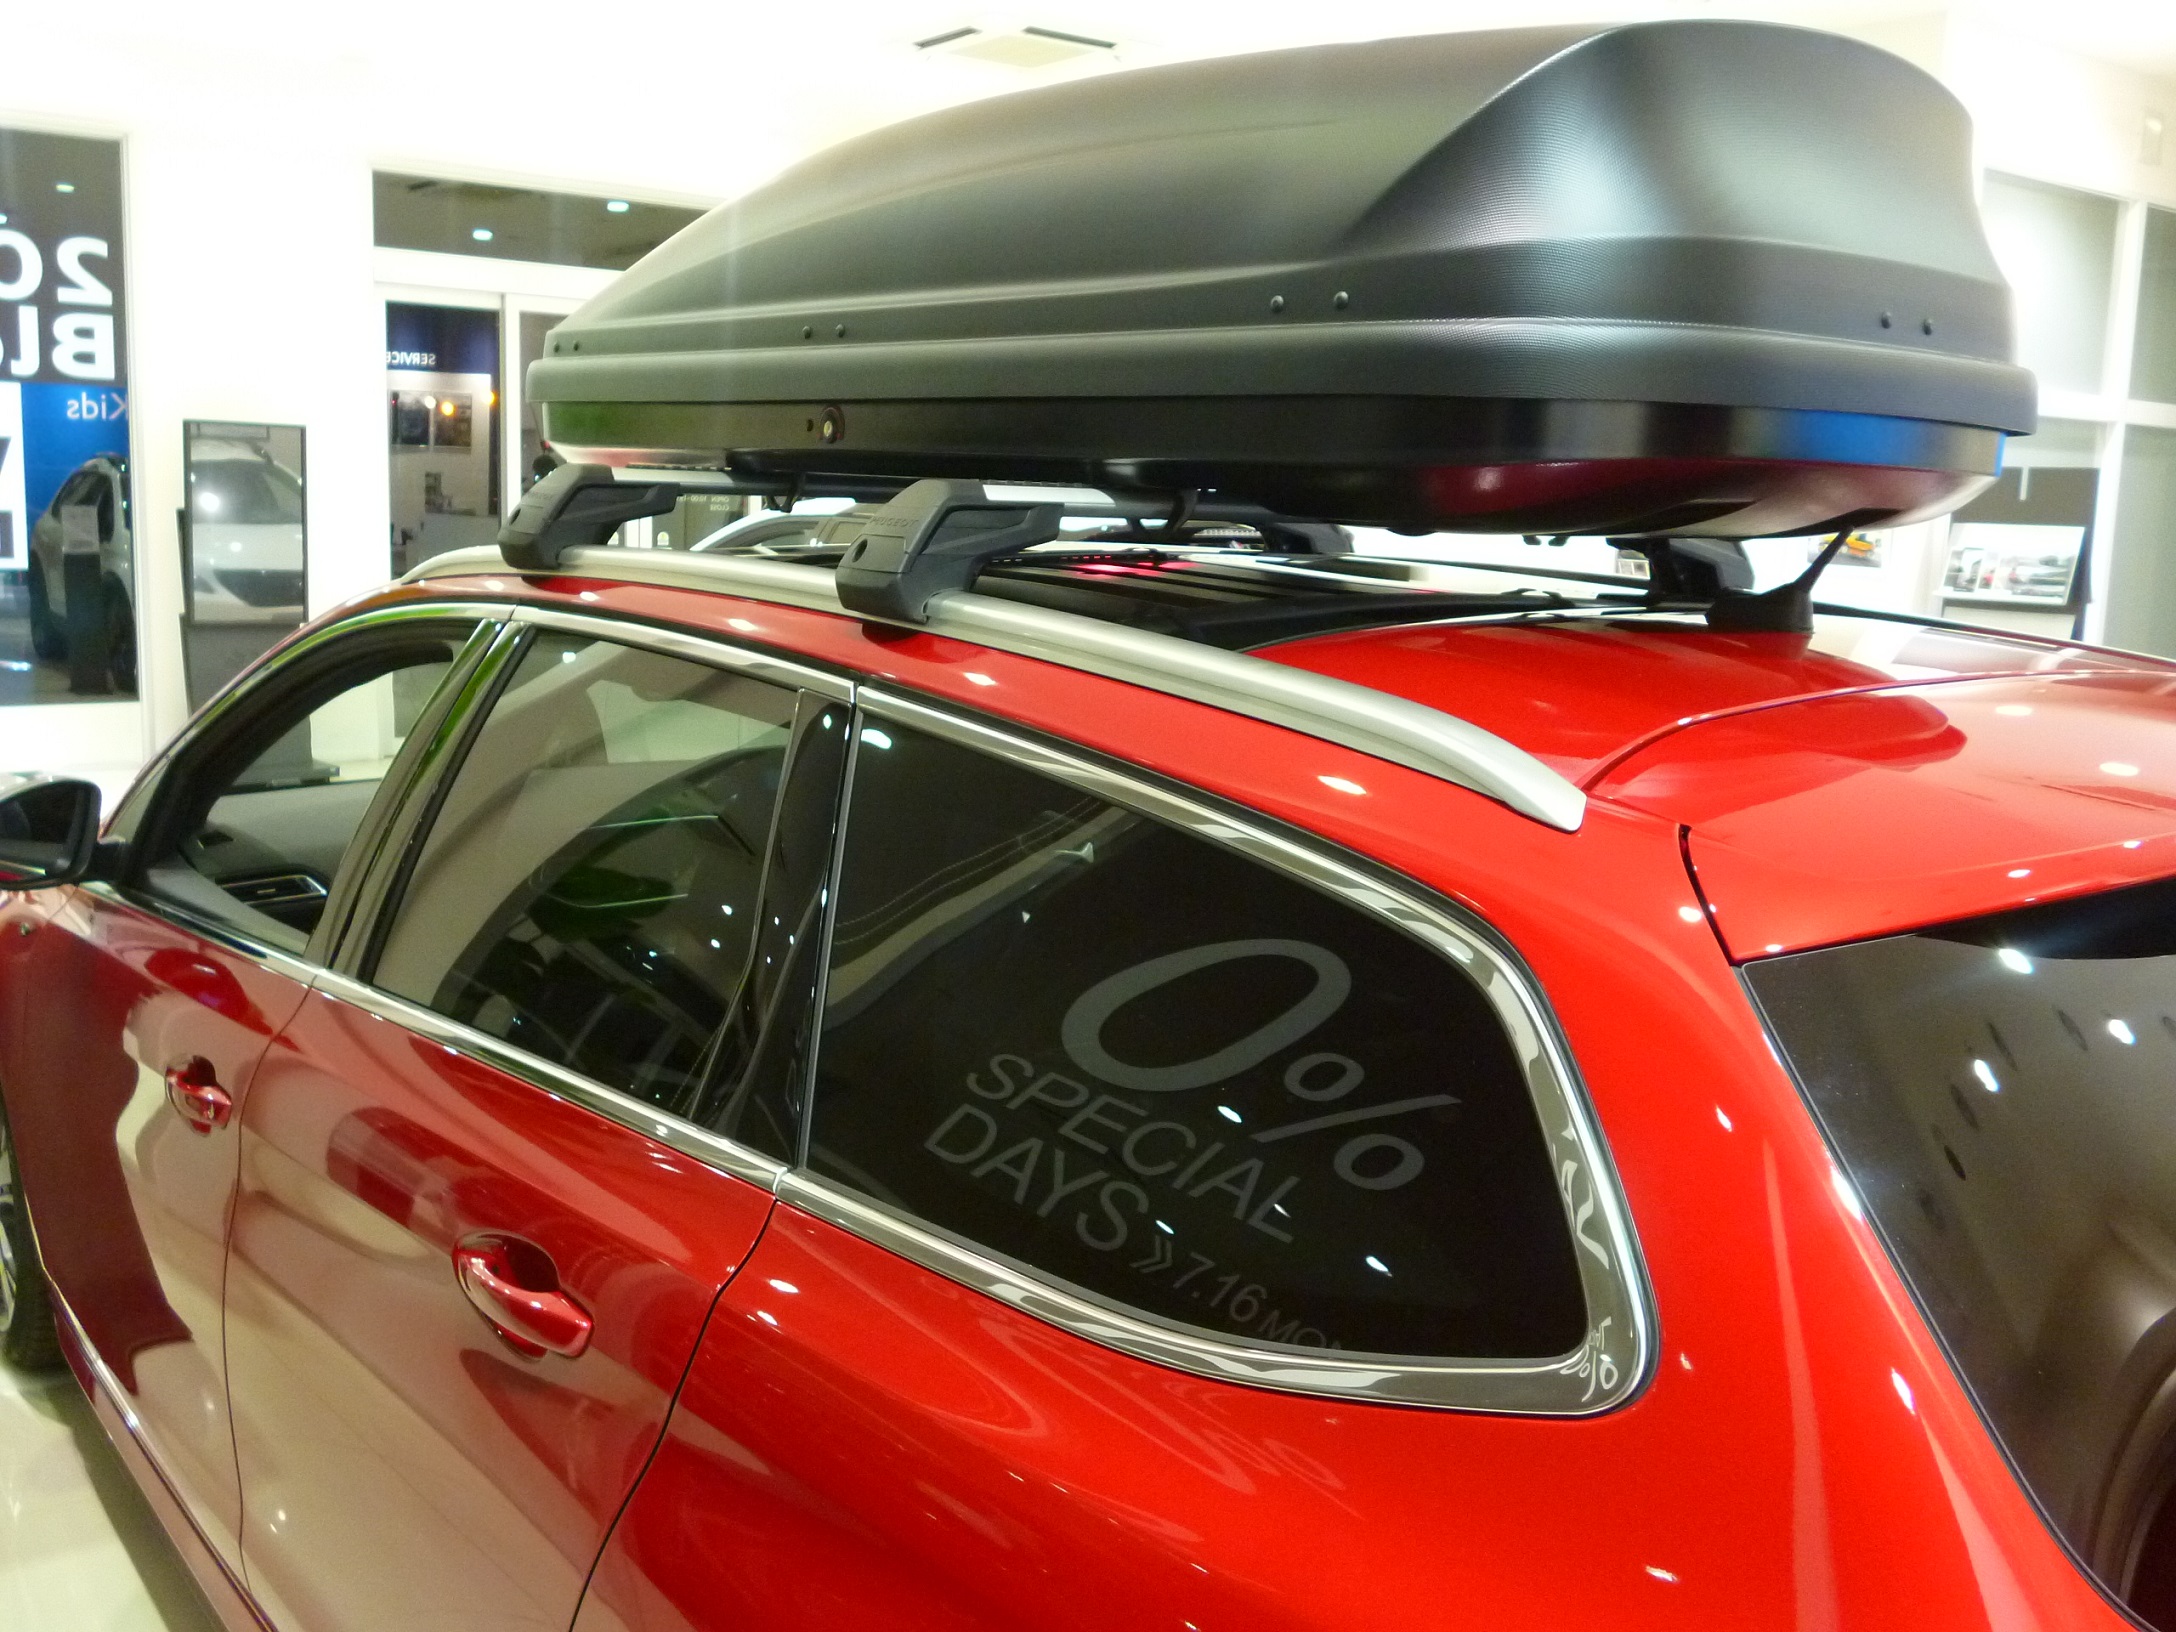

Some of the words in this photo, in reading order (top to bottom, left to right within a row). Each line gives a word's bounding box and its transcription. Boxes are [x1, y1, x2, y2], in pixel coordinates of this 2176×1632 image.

[869, 516, 920, 528] PEUGEOT
[924, 1103, 1150, 1251] DAYS
[965, 1053, 1299, 1244] SPECIAL
